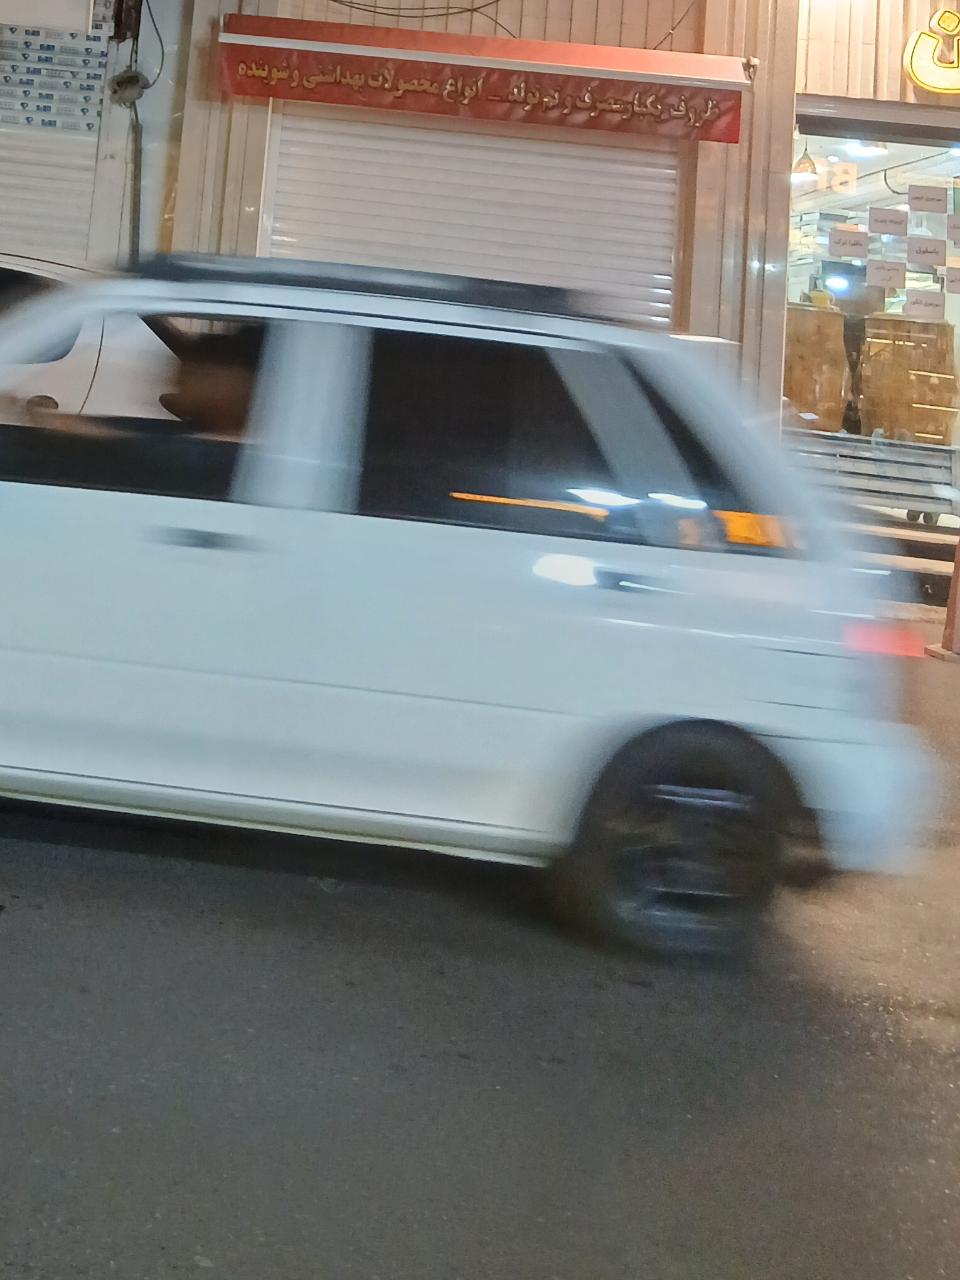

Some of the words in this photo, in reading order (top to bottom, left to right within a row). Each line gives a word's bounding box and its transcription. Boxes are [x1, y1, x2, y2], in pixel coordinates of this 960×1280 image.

[238, 59, 290, 86] شوینده
[290, 69, 300, 88] و
[302, 64, 365, 91] بهداشتی
[561, 94, 572, 114] و
[670, 95, 721, 127] ظروف
